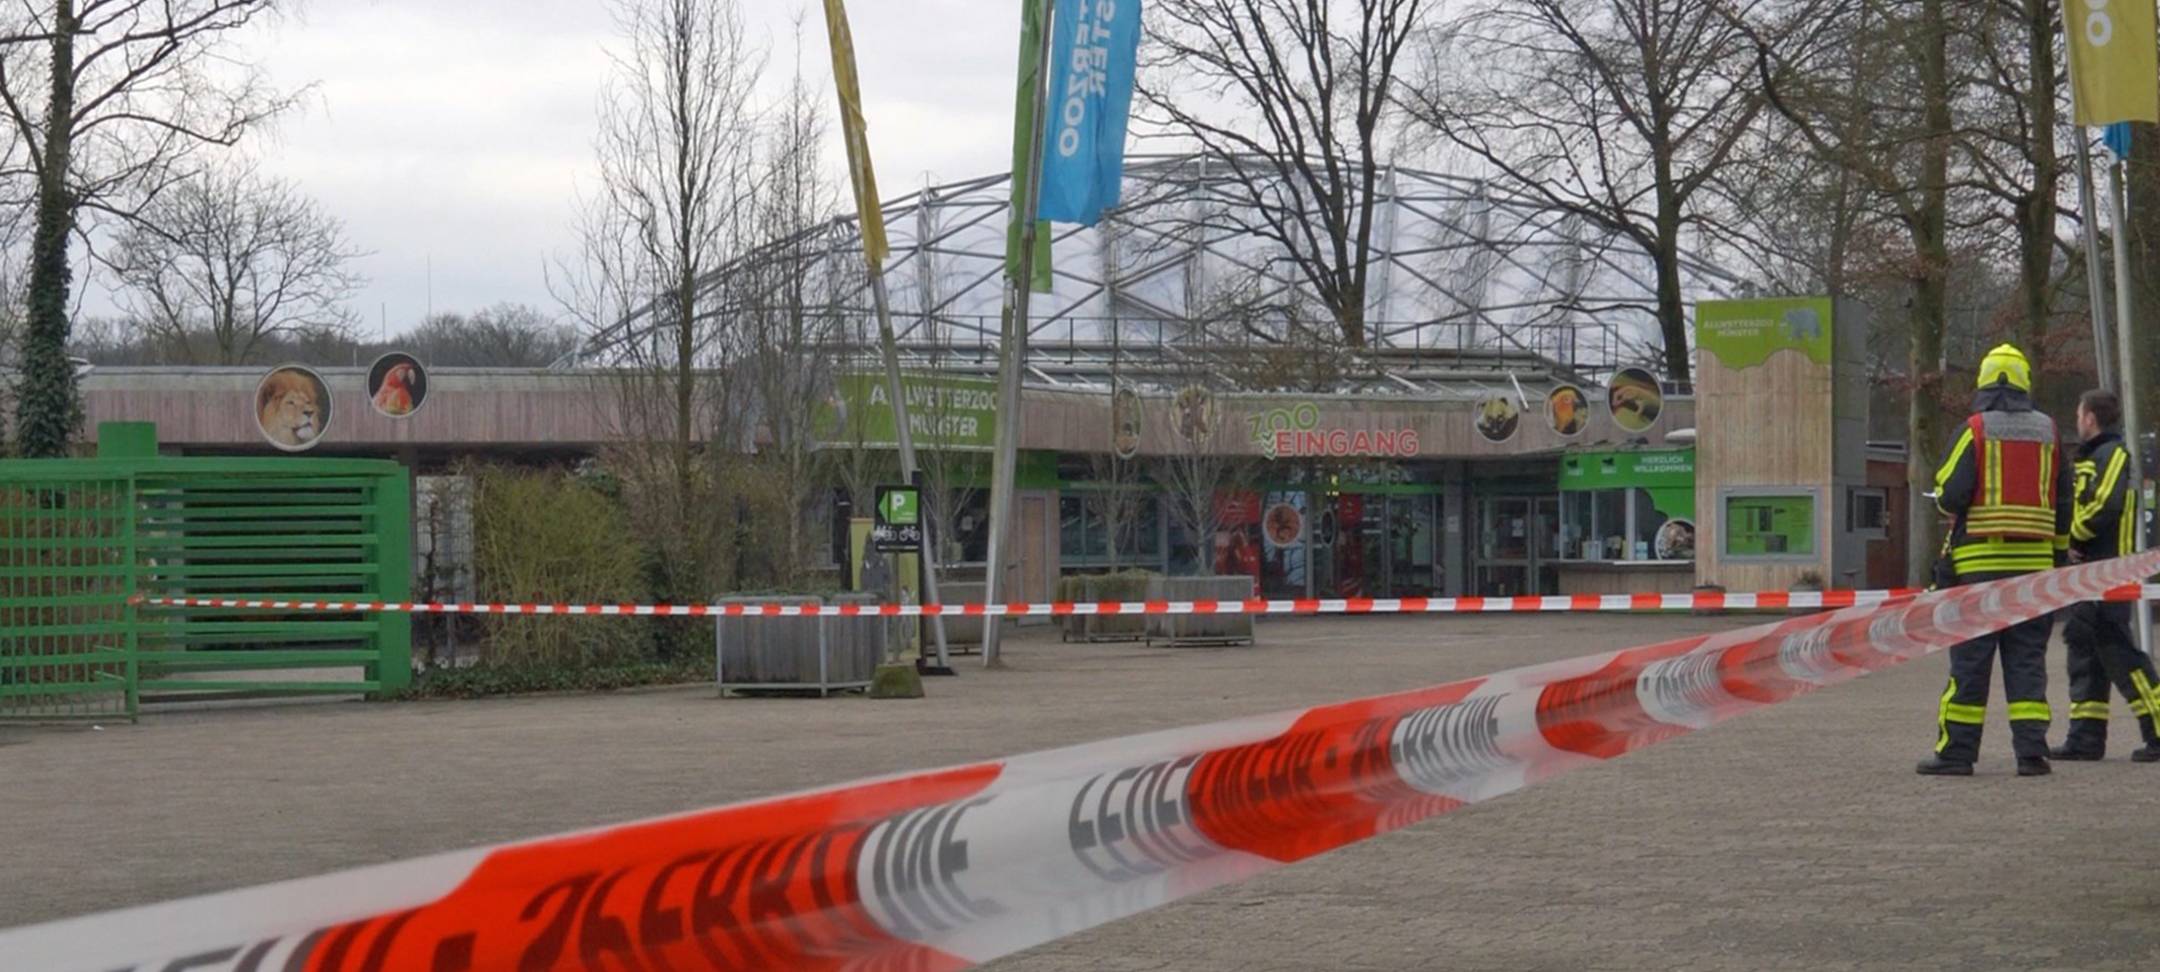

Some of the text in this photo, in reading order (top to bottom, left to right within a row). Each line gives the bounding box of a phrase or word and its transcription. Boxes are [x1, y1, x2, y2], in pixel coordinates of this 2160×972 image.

[869, 383, 997, 411] ALWETTERZOO
[1247, 402, 1320, 443] ZOO
[1275, 429, 1419, 457] EINGANG
[1633, 465, 1694, 473] WILLKOMMEN
[1641, 455, 1685, 464] HERZLICH
[892, 493, 906, 511] P
